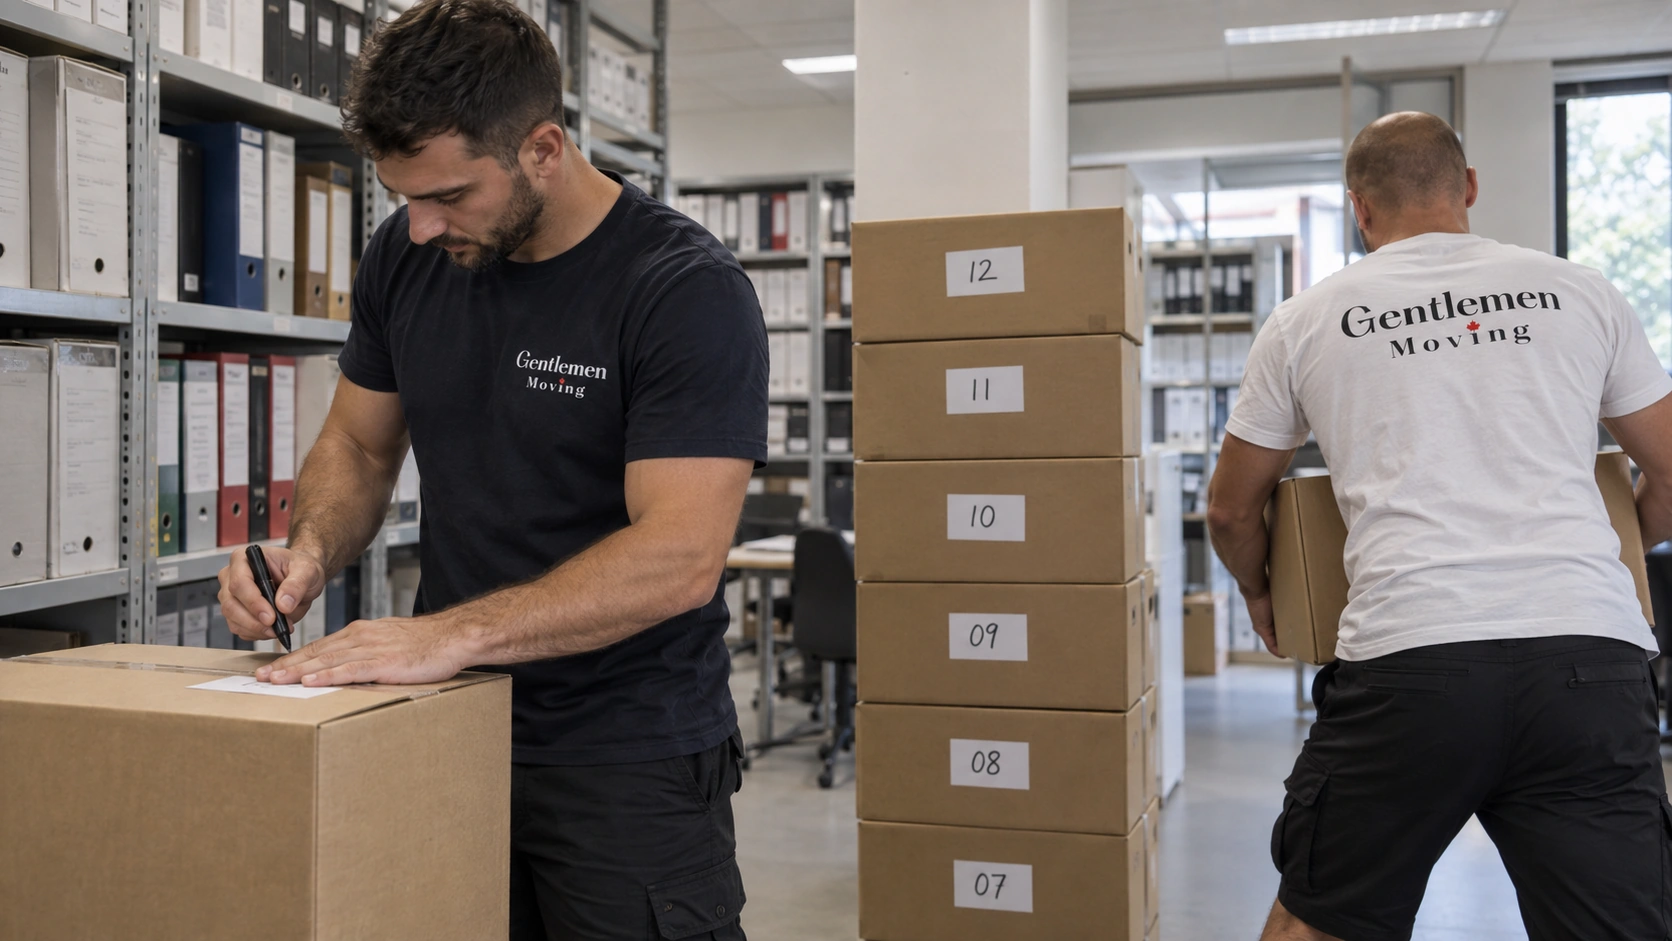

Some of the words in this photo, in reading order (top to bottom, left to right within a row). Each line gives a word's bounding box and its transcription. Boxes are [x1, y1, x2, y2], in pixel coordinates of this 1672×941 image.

[969, 259, 998, 283] 12
[1340, 290, 1562, 338] Gentlemen
[1389, 322, 1532, 359] Moving
[515, 349, 608, 380] Gentlemen
[526, 376, 586, 399] Moving
[972, 377, 989, 401] 11
[970, 504, 996, 529] 10
[969, 622, 999, 650] 09
[970, 749, 1001, 776] 08
[974, 872, 1007, 900] 07
